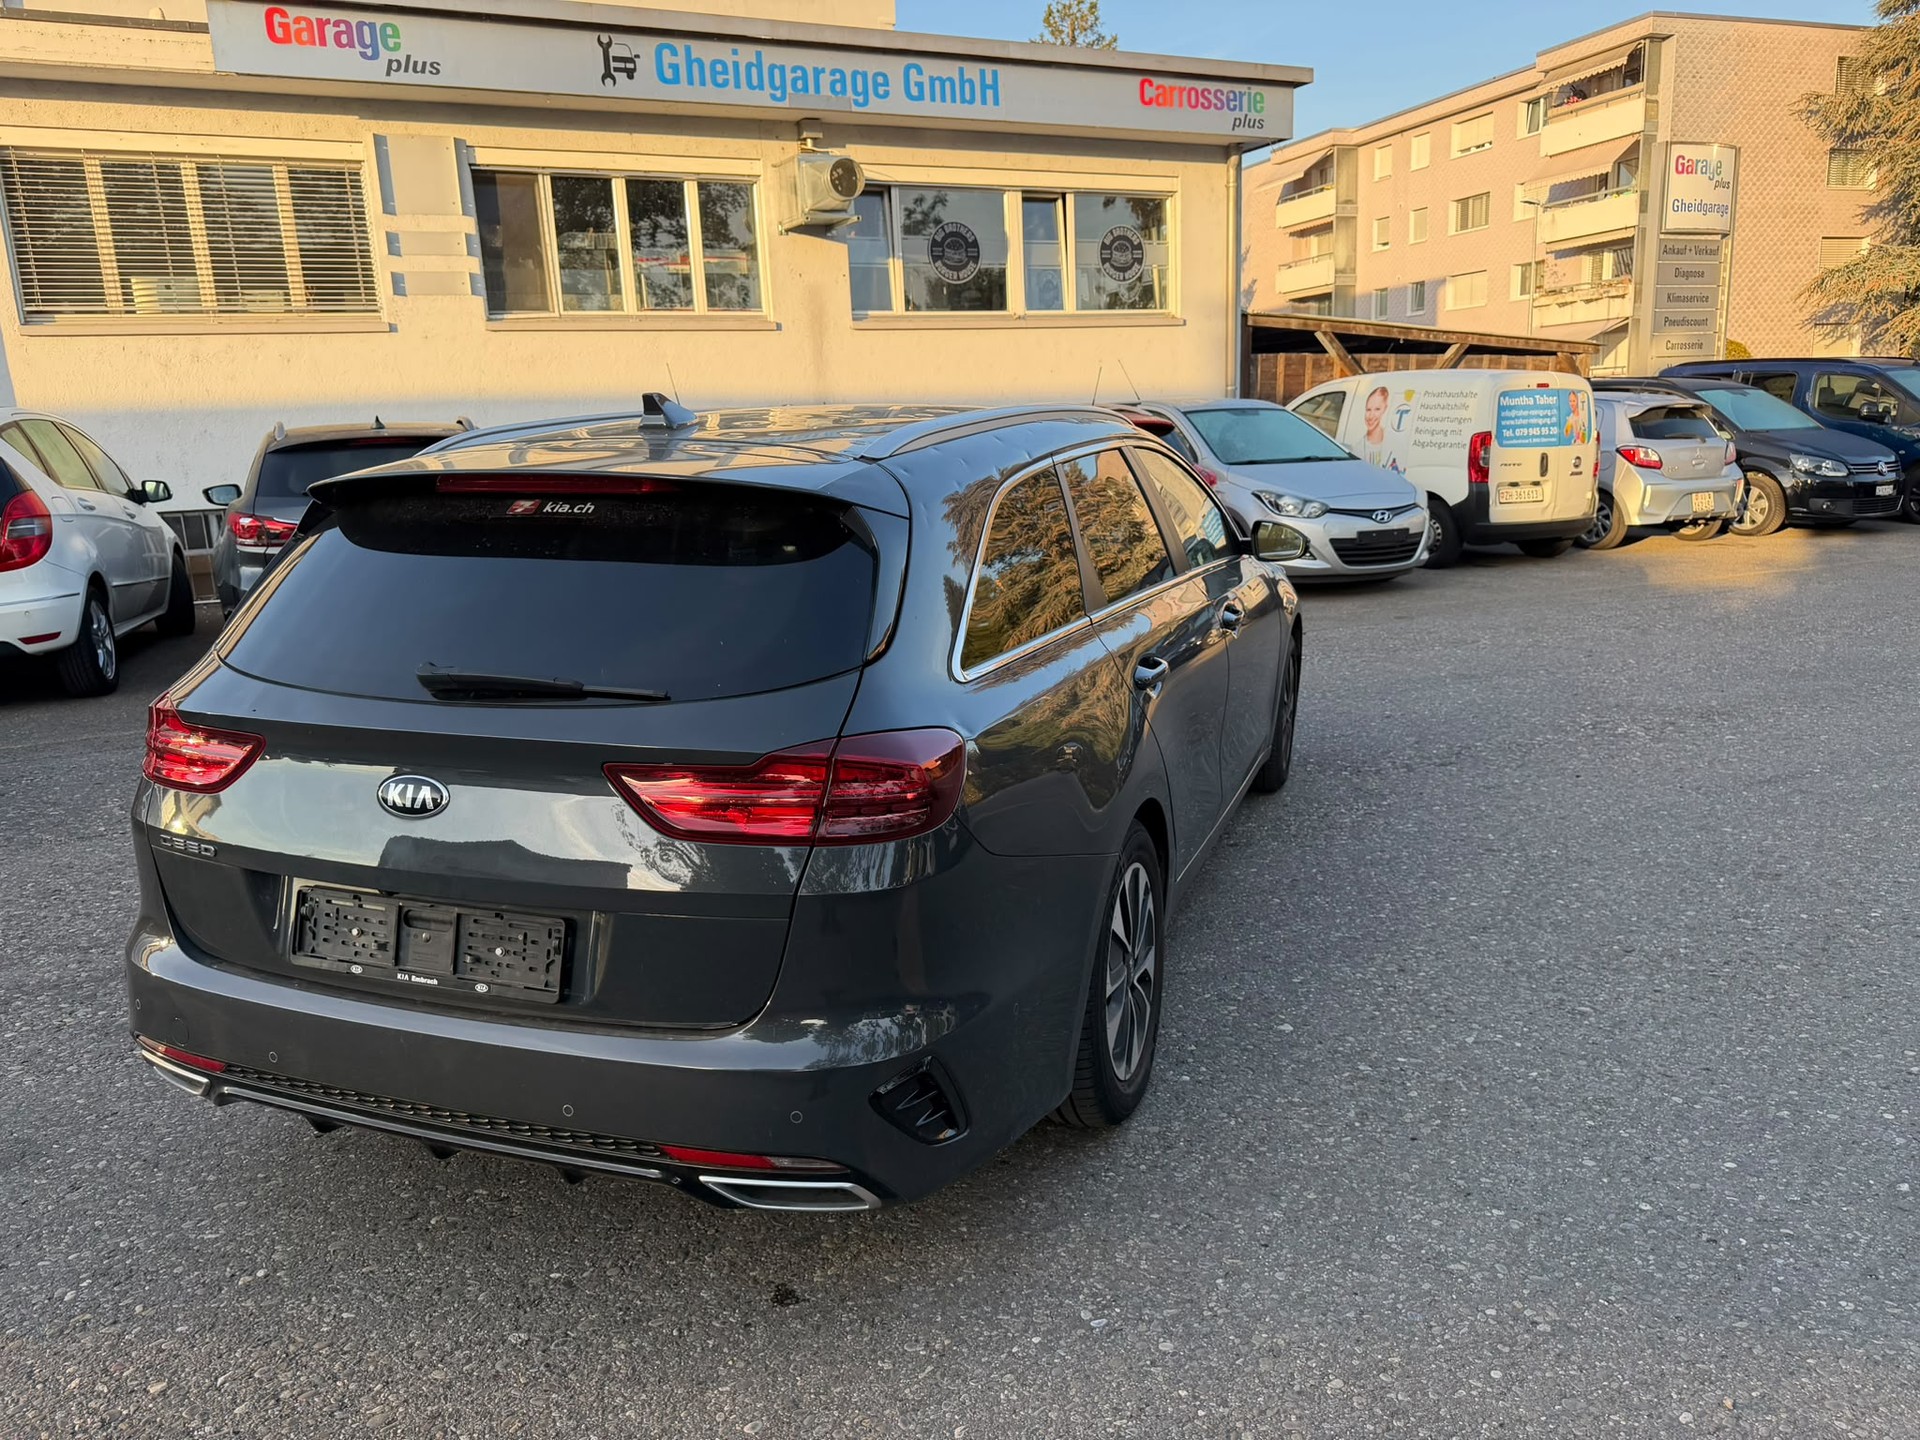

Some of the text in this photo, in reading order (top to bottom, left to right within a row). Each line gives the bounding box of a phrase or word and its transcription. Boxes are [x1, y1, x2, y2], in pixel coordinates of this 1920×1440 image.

[264, 6, 402, 61] Garage
[385, 54, 441, 77] plus
[654, 42, 1000, 108] Gheidgarage GmbH
[1139, 77, 1265, 113] Carrosserie
[1231, 114, 1265, 131] plus
[1674, 154, 1723, 181] Garage
[1713, 176, 1731, 190] plus
[1672, 198, 1729, 220] Gheidgarage
[1662, 244, 1687, 256] Ankauf
[1694, 244, 1720, 256] Verkauf
[1674, 267, 1705, 280] Diagnose
[1666, 292, 1710, 303] Klimaservice
[1664, 316, 1708, 327] Pneudiscount
[1665, 339, 1704, 351] Carrosserie
[1423, 390, 1478, 399] Privathaushalte
[1500, 394, 1558, 406] Muntha Taher
[1417, 414, 1473, 425] Hauswartungen
[1414, 426, 1462, 437] Reinigung mit
[1412, 439, 1467, 449] Abgabegarantie
[543, 501, 596, 514] kia.ch
[387, 782, 435, 809] KIA
[160, 834, 216, 857] CEED
[397, 973, 438, 985] KIA Embrach
